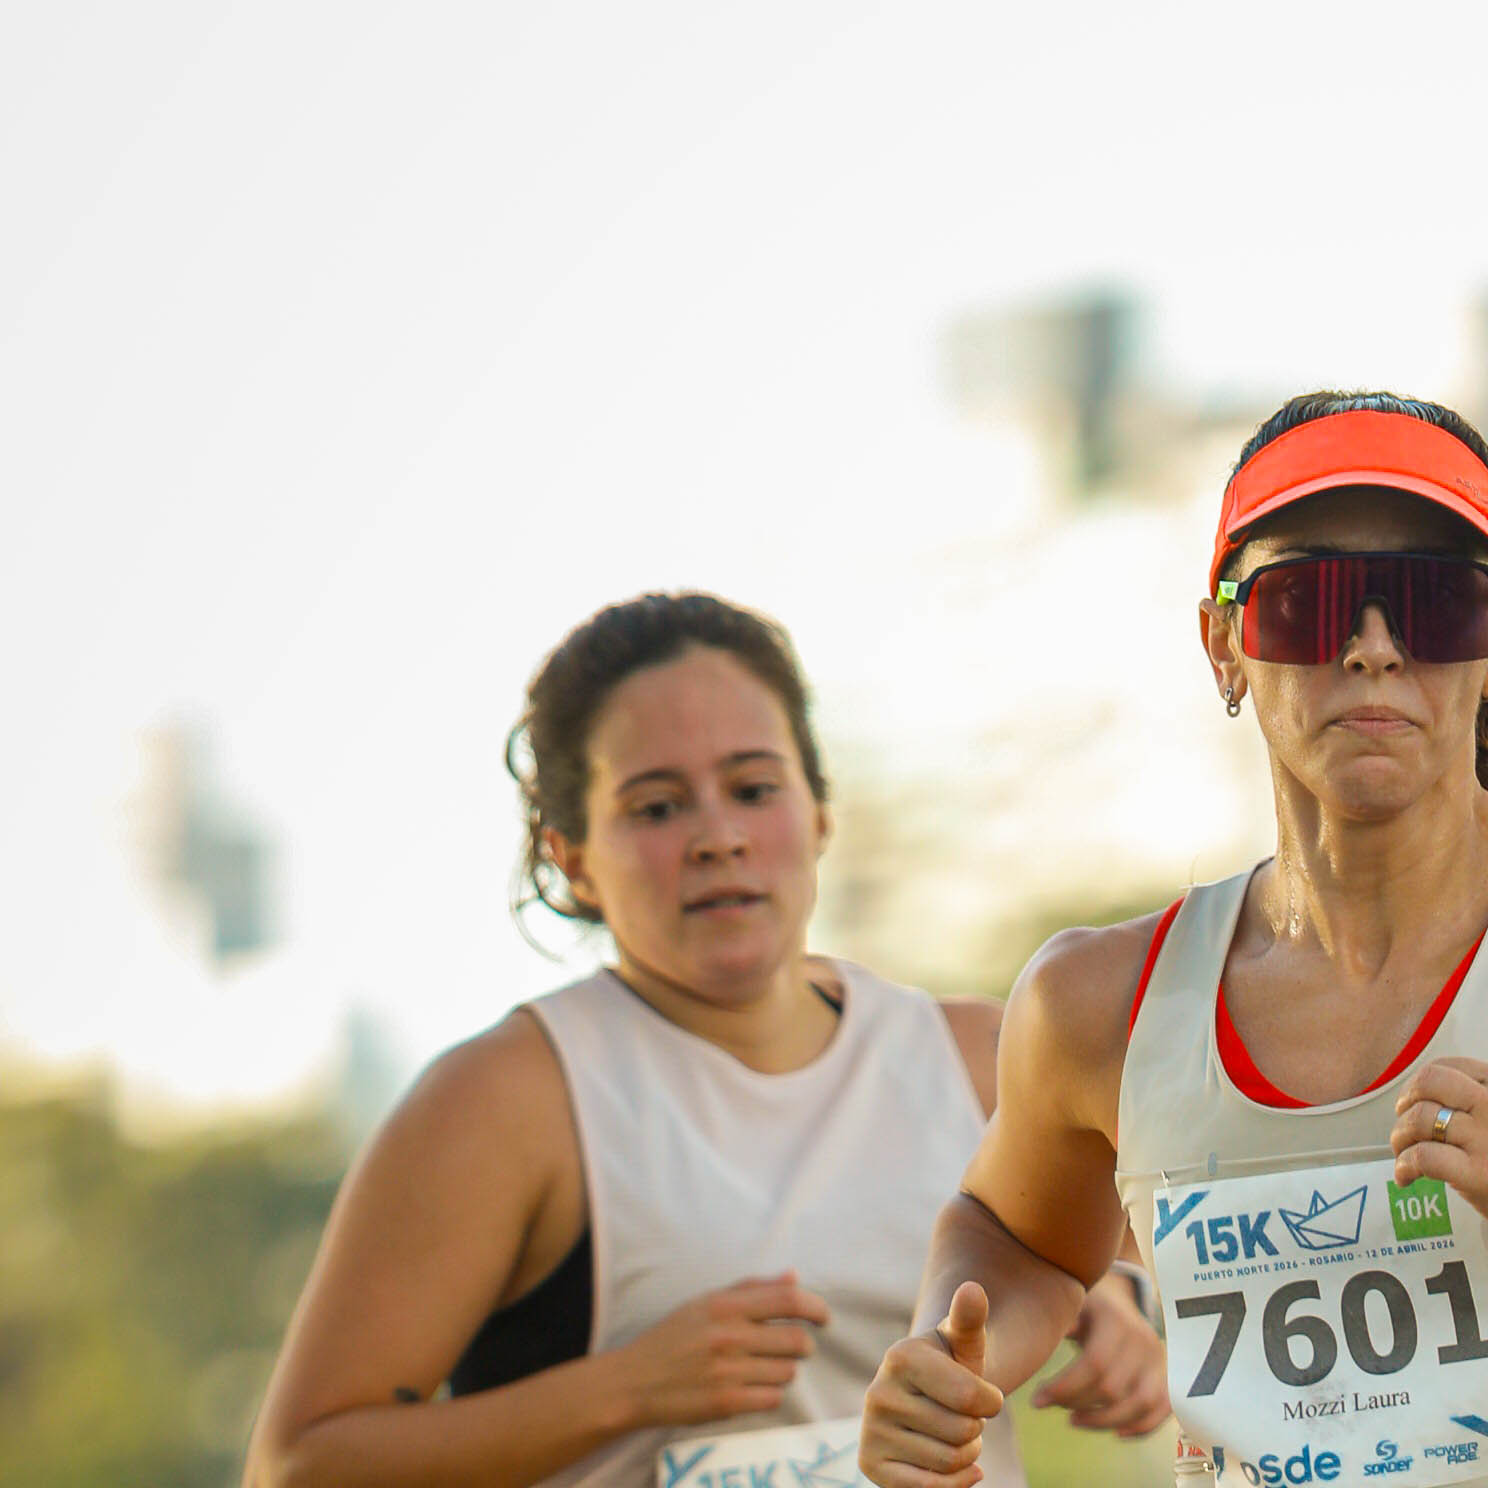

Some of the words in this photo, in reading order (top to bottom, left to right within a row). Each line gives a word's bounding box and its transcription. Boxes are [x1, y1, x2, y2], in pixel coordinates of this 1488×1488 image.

[1396, 1192, 1443, 1222] 10K
[1186, 1209, 1280, 1265] 15K
[1193, 1268, 1233, 1282] PUERTO
[1236, 1263, 1270, 1277] NORTE
[1273, 1260, 1298, 1272] 2026
[1309, 1252, 1354, 1266] ROSARIO
[1366, 1248, 1377, 1258] 12
[1380, 1246, 1394, 1256] DE
[1397, 1243, 1427, 1254] ABRIL
[1430, 1239, 1455, 1250] 2026
[1282, 1395, 1346, 1421] Mozzi
[1353, 1390, 1411, 1413] Laura
[1424, 1441, 1478, 1459] POWER
